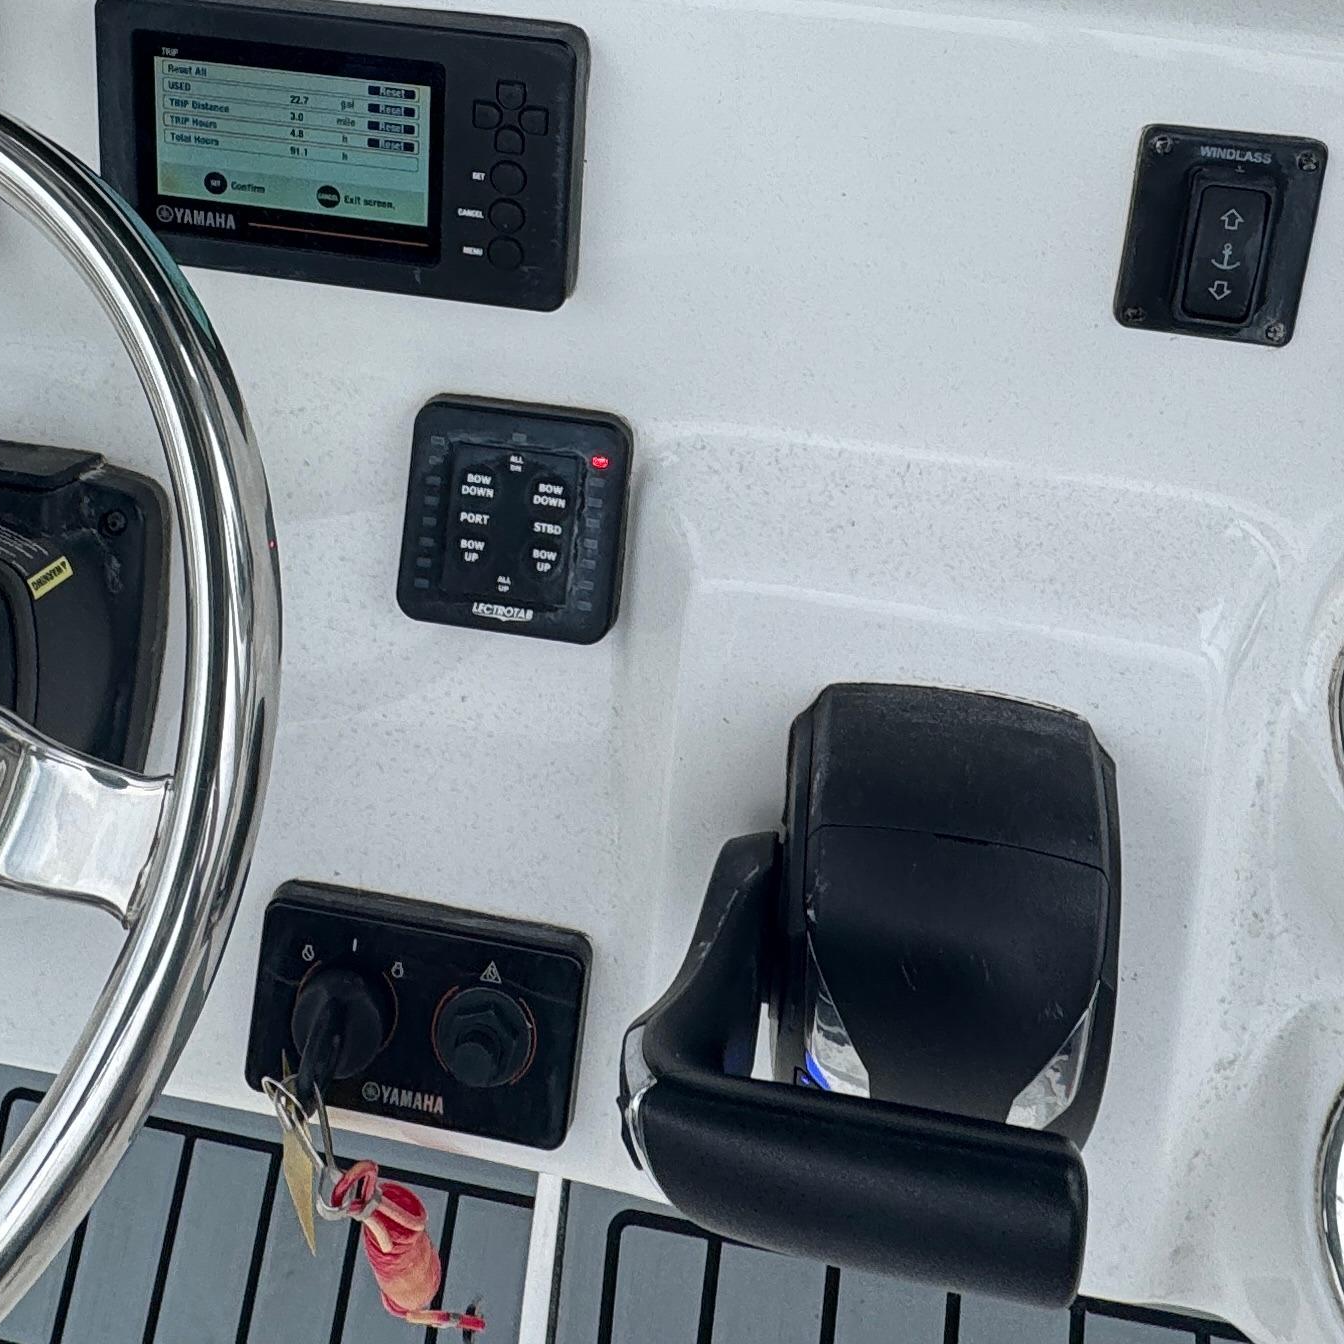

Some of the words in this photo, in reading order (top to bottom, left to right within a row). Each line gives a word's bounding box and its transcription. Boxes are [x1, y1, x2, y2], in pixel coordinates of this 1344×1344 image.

[161, 46, 179, 56] TRIP
[167, 80, 191, 92] USED
[169, 97, 190, 109] TRIP
[191, 101, 230, 113] Distance
[289, 95, 309, 105] 22.7
[169, 115, 190, 126] TRIP
[192, 118, 218, 129] Hours
[169, 132, 192, 143] Total
[194, 134, 220, 146] Hours
[1200, 145, 1272, 165] WINDLASS
[230, 180, 266, 194] Confirm
[343, 194, 361, 205] Exit
[174, 206, 236, 230] YAMAHA
[457, 207, 484, 219] CANCEL
[466, 473, 492, 485] BOW
[461, 484, 495, 498] DOWN
[538, 483, 564, 496] BOW
[533, 494, 566, 509] DOWN
[459, 511, 490, 526] PORT
[533, 521, 562, 536] STBD
[460, 539, 485, 552] BOW
[463, 551, 479, 563] UP
[532, 548, 557, 562] BOW
[536, 560, 552, 573] UP
[497, 575, 512, 585] ALL
[498, 583, 510, 593] UP
[472, 601, 534, 622] LECTROTAB
[379, 1084, 444, 1115] YAMAHA
